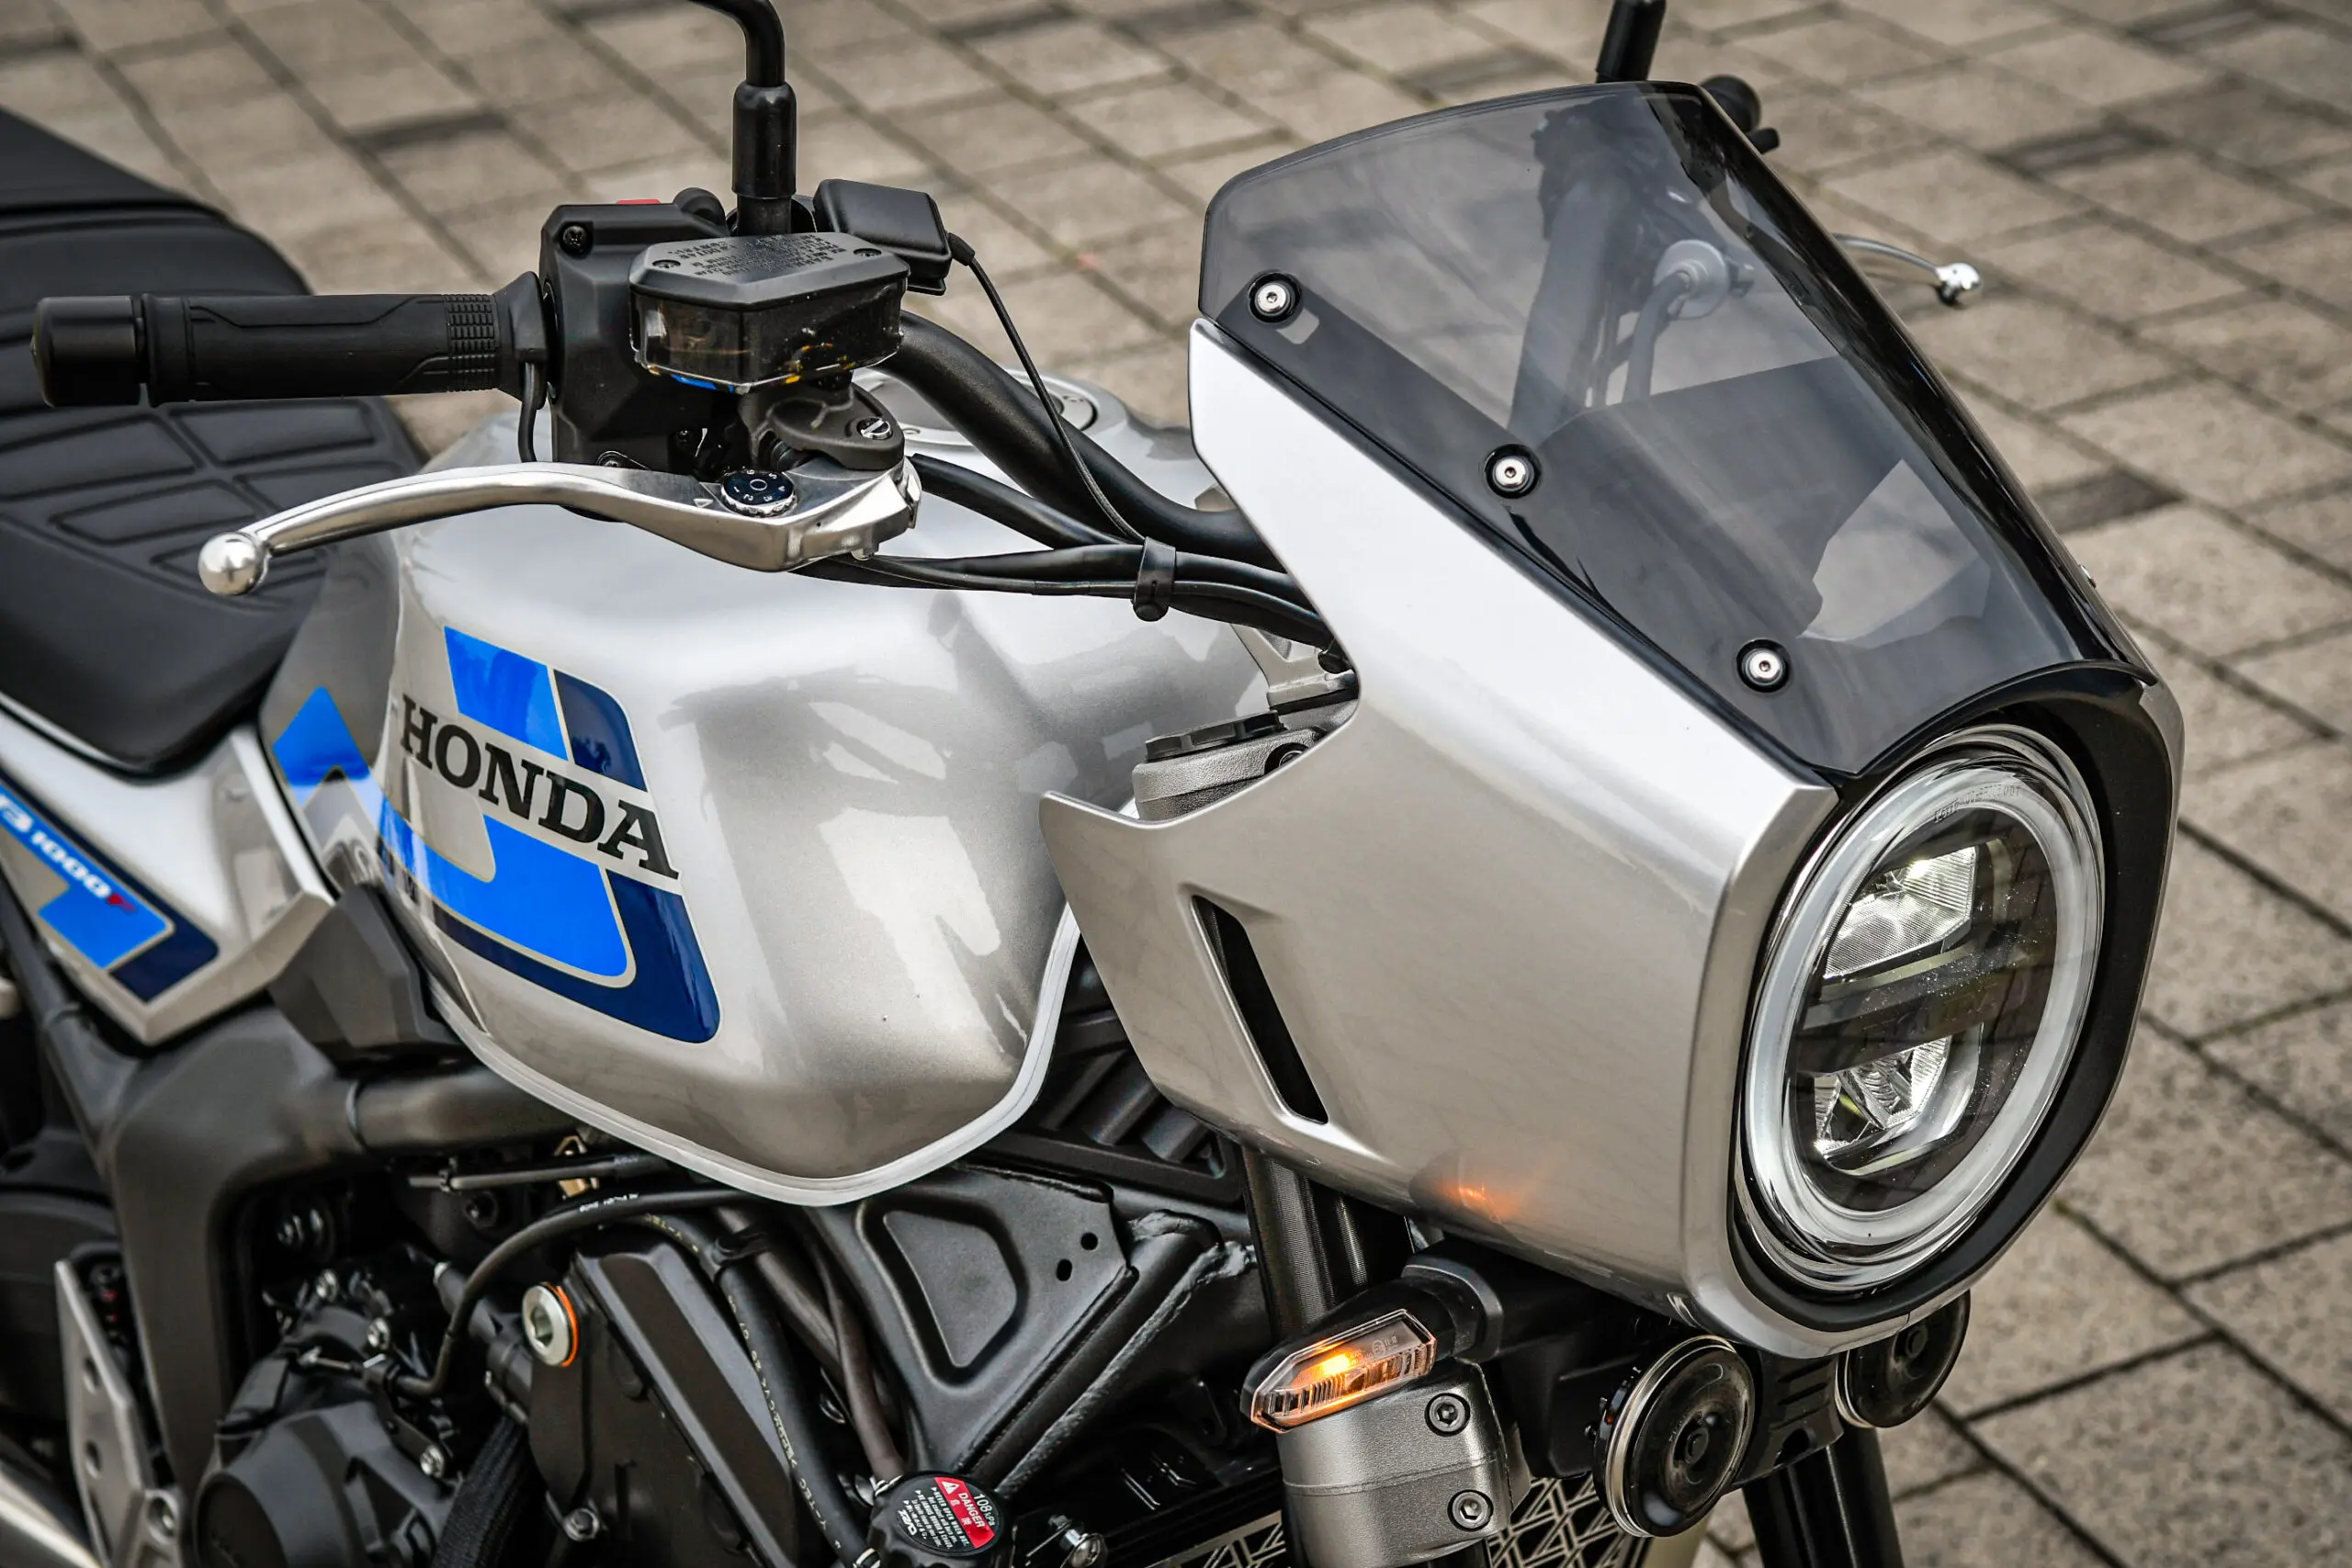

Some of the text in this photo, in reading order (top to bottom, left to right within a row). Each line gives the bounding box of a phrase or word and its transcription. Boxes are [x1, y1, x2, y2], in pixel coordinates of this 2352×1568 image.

[400, 693, 680, 880] HONDA
[957, 1492, 986, 1528] DANGER
[973, 1493, 993, 1513] 108
